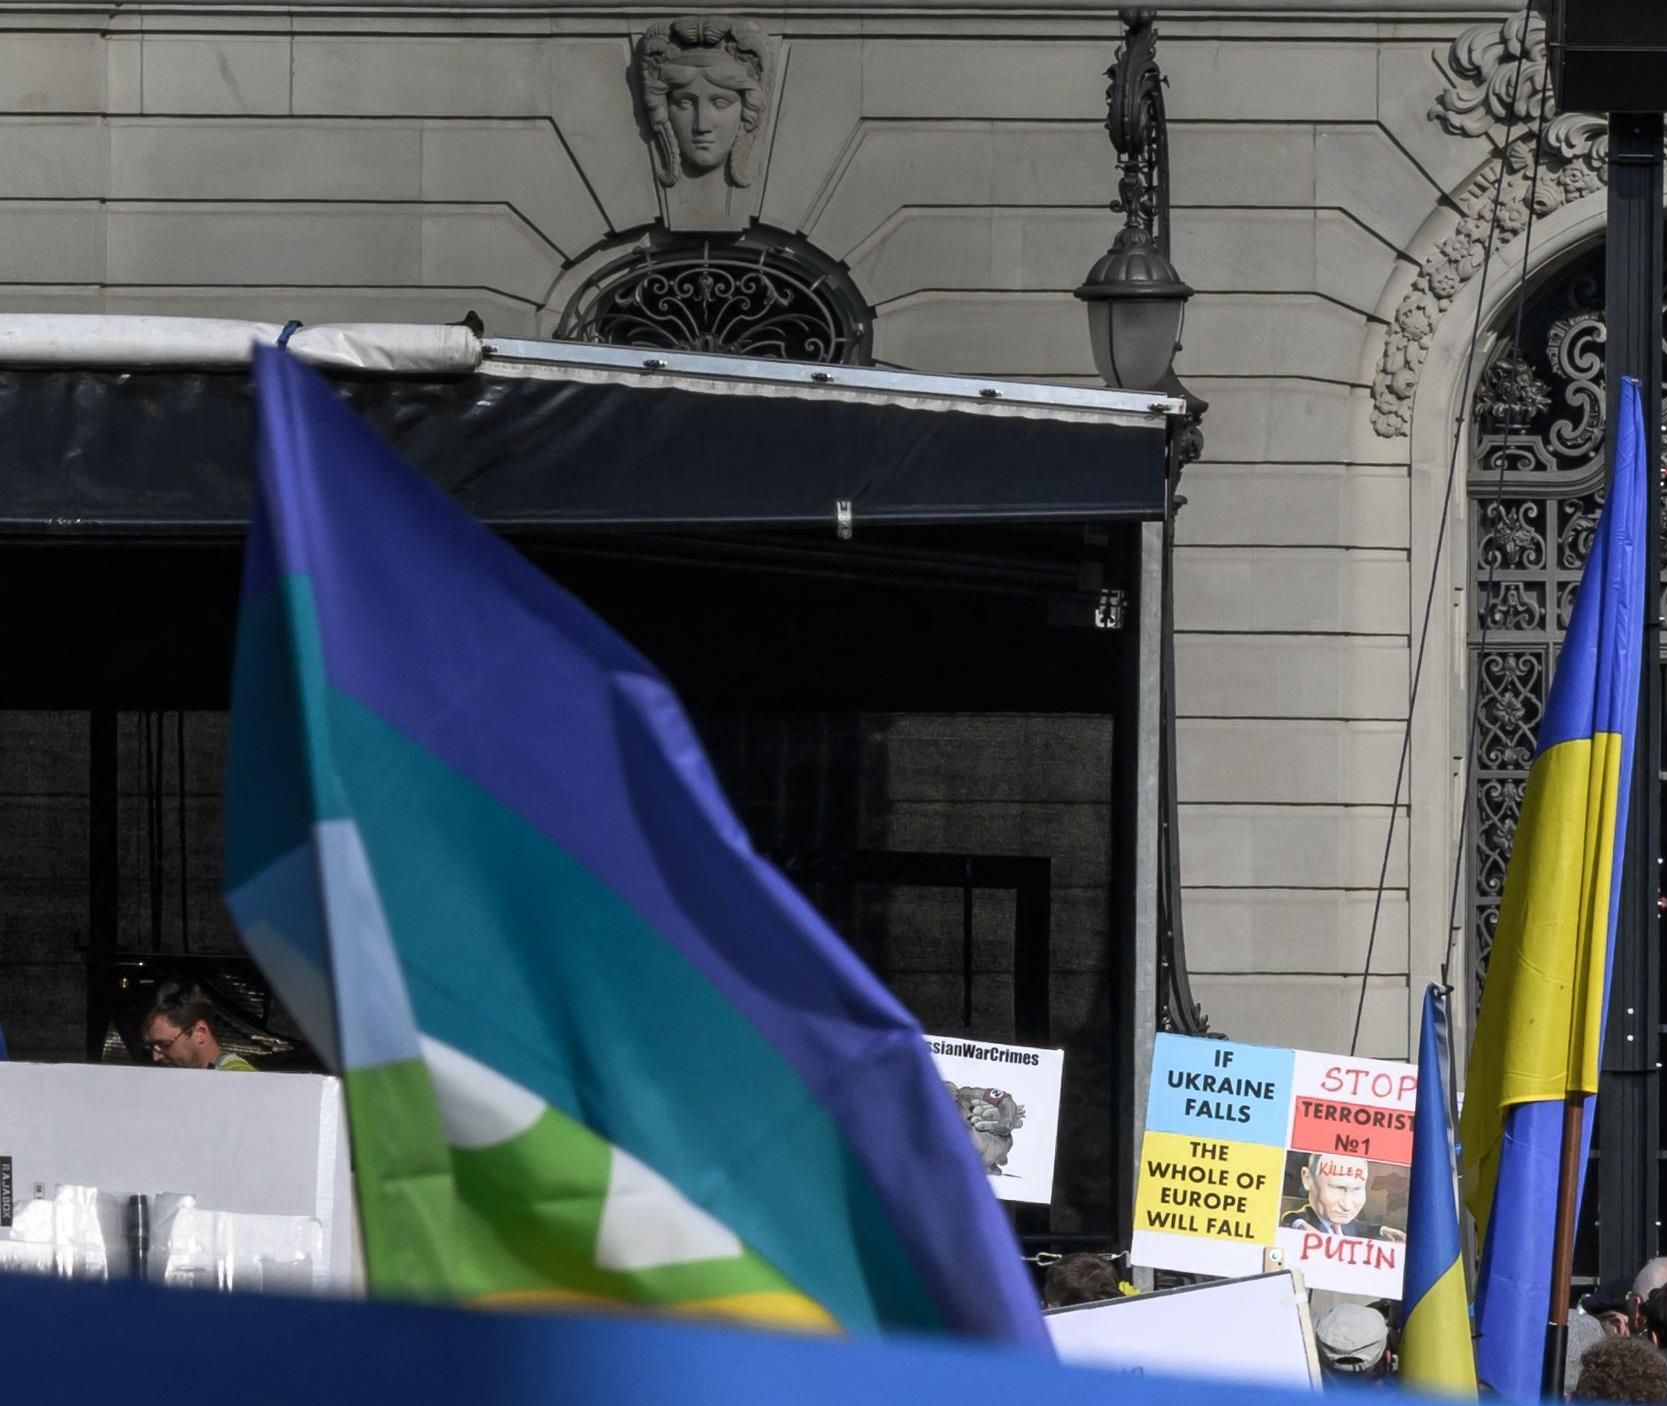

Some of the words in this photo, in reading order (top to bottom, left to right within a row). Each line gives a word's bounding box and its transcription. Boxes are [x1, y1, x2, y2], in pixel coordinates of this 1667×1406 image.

[927, 1041, 1039, 1066] ssianWarCrimes
[1214, 1049, 1234, 1068] IF
[1168, 1070, 1275, 1100] UKRAINE
[1321, 1067, 1418, 1101] STOP
[1185, 1098, 1251, 1123] FALLS
[1302, 1101, 1415, 1132] TERRORIST
[1190, 1141, 1229, 1161] THE
[1147, 1160, 1229, 1186] WHOLE
[1236, 1172, 1267, 1190] OF
[2, 1163, 11, 1218] RAJABOX
[1160, 1187, 1247, 1213] EUROPE
[1147, 1210, 1198, 1232] WILL
[1206, 1218, 1255, 1239] FALL
[1300, 1233, 1396, 1269] PUTIN
